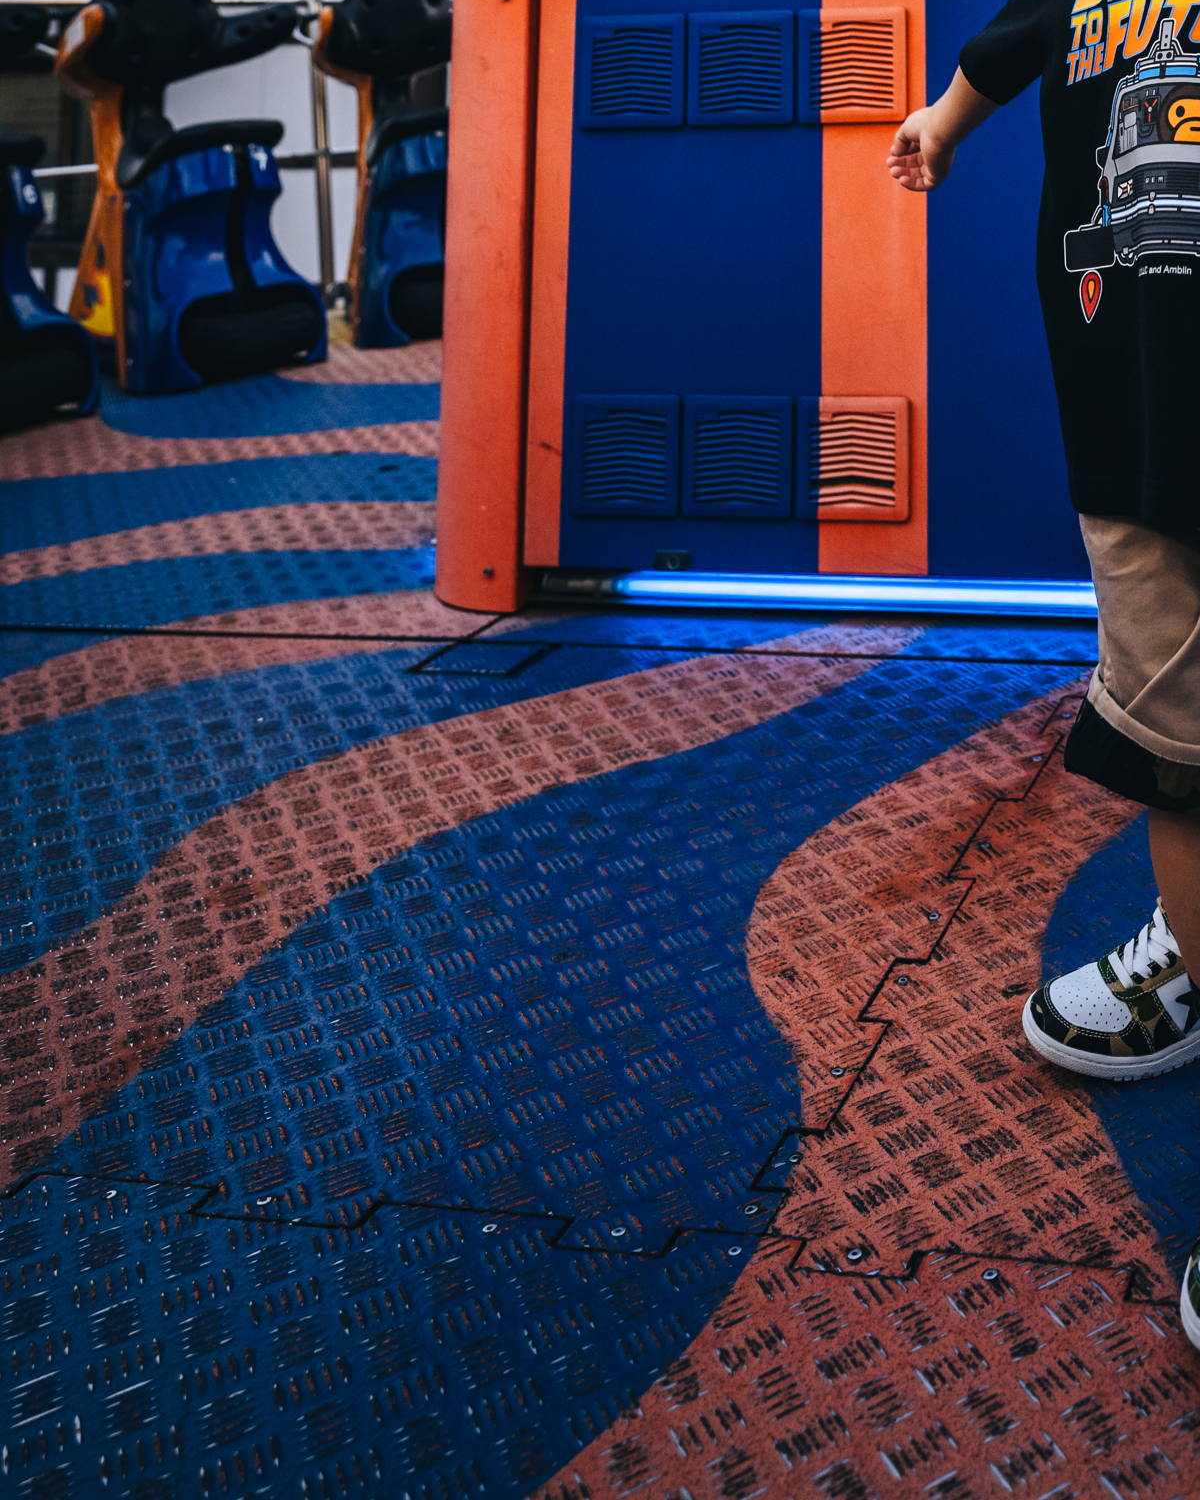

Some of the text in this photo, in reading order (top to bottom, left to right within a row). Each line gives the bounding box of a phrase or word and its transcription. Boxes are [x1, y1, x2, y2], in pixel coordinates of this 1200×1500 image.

[1070, 7, 1103, 51] TO
[1066, 42, 1106, 86] THE
[1149, 265, 1162, 274] and
[1163, 265, 1192, 275] Amblin
